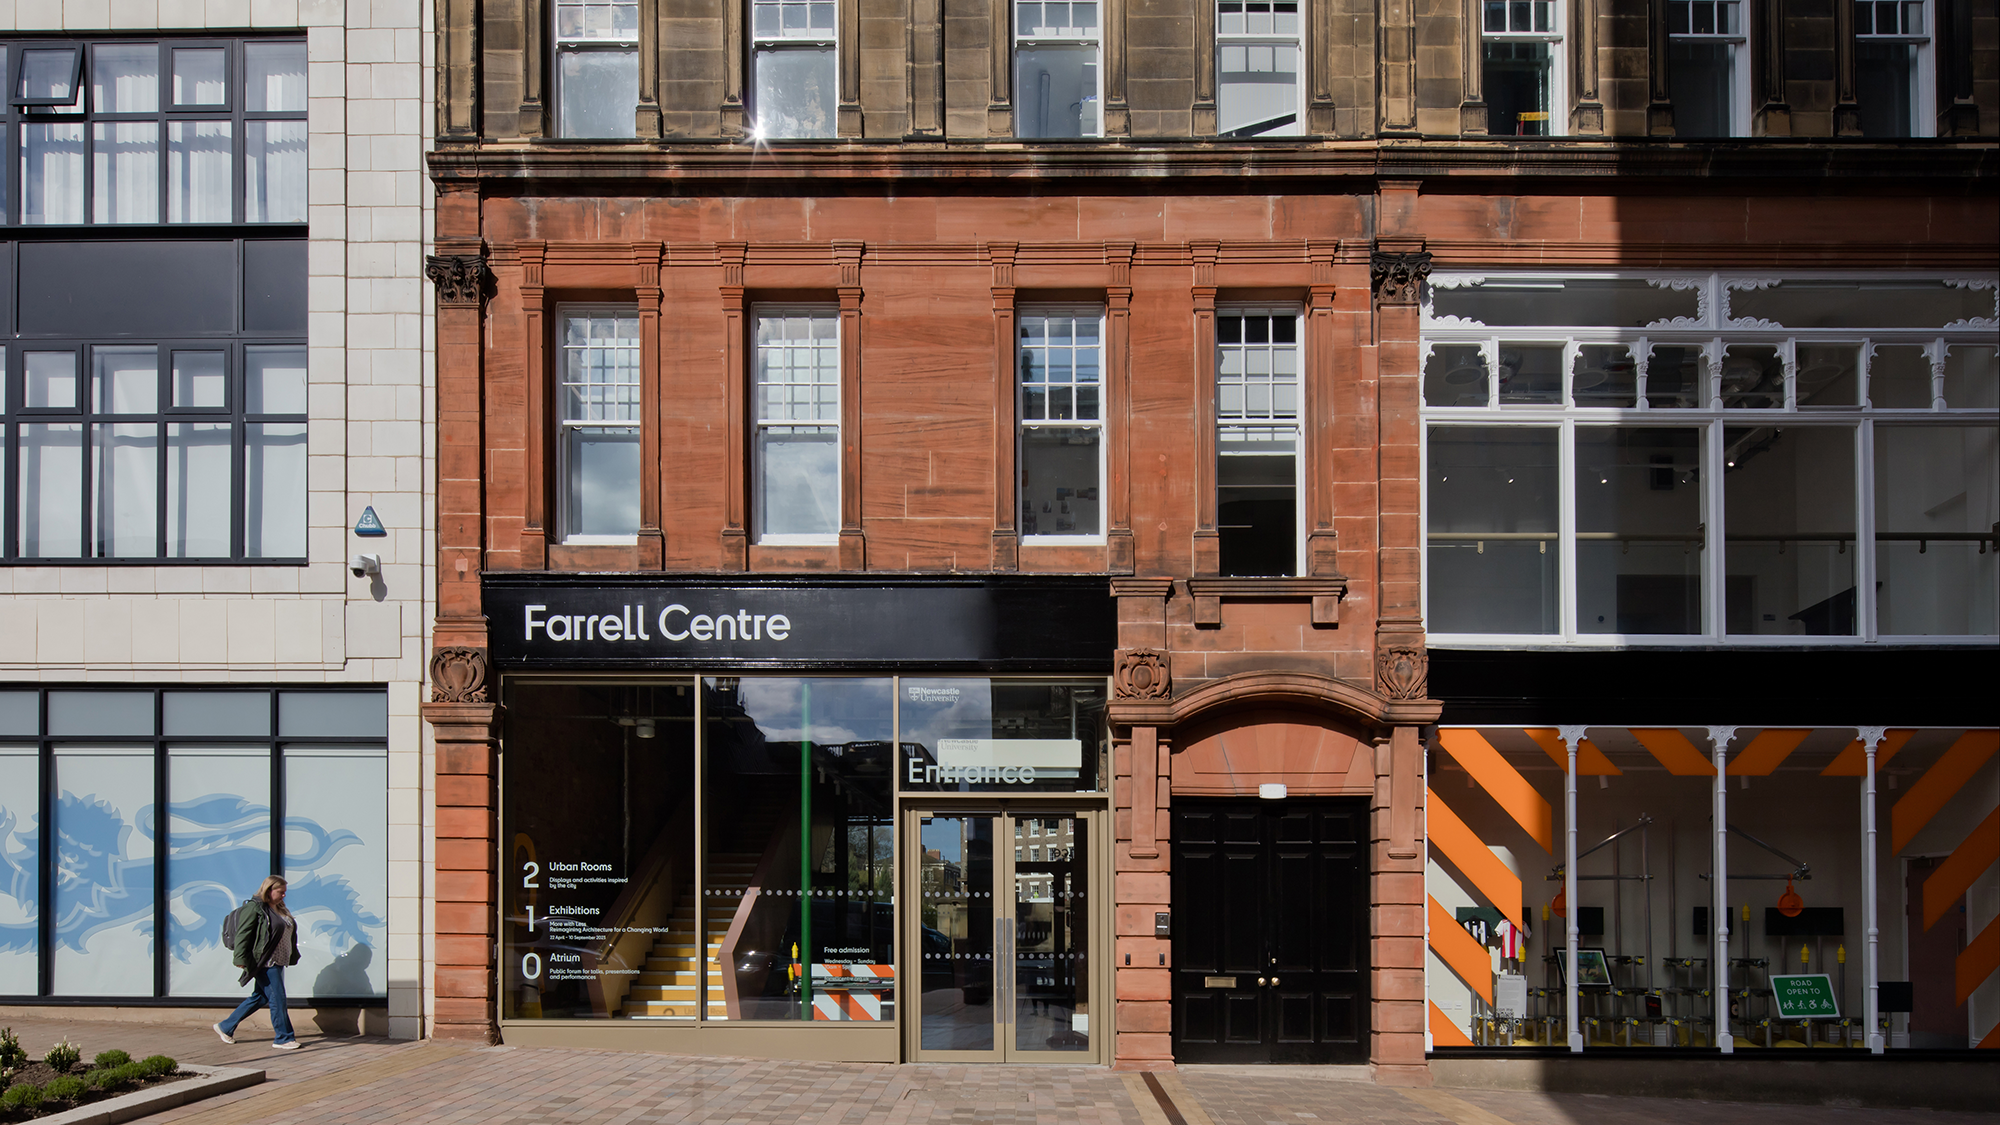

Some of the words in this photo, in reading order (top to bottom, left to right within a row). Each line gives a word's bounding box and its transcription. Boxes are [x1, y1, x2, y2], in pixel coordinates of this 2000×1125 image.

[525, 604, 650, 641] Farrell
[658, 604, 792, 641] Centre
[920, 687, 960, 695] Newcastle
[920, 694, 960, 704] University
[908, 757, 1036, 784] Entrance
[523, 861, 540, 888] 2
[549, 861, 578, 871] Urban
[580, 861, 612, 871] Rooms
[525, 905, 535, 932] 1
[549, 905, 600, 915] Exhibitions
[522, 952, 542, 980] 0
[549, 952, 580, 962] Atrium
